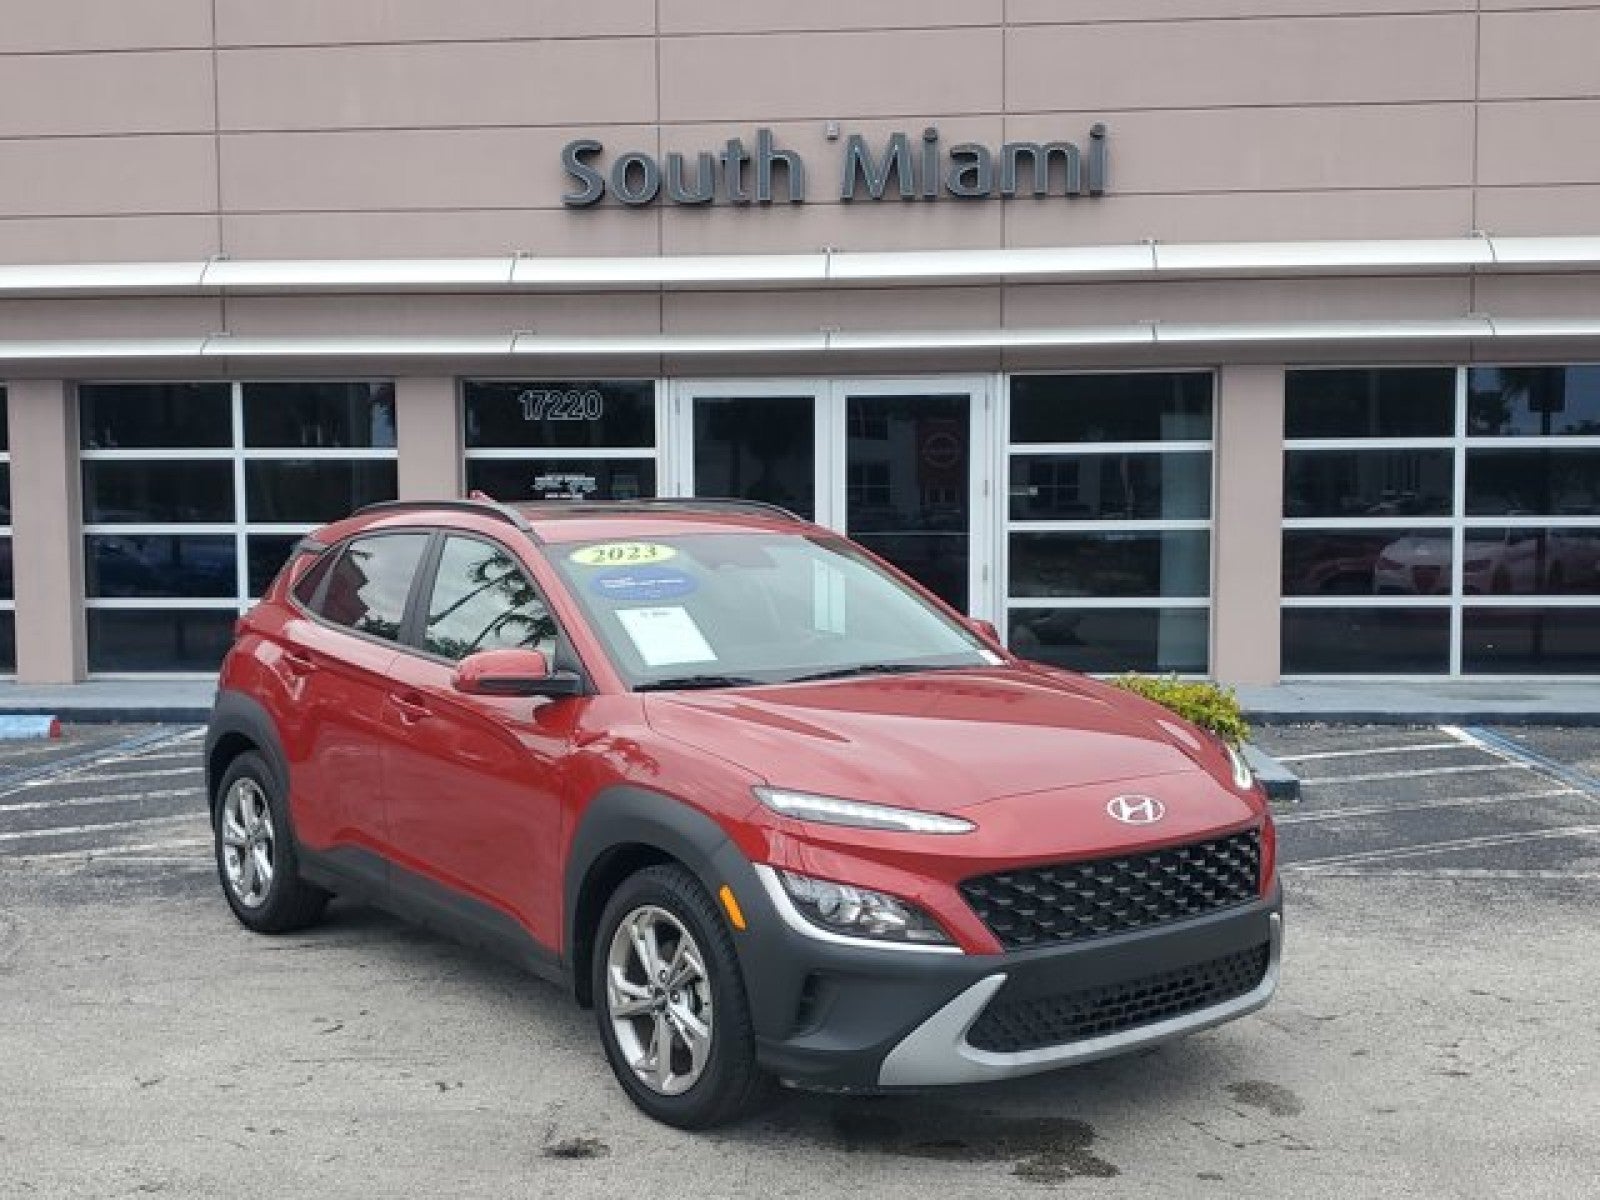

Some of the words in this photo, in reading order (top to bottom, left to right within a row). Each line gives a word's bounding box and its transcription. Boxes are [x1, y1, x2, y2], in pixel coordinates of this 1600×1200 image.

[561, 127, 806, 208] South
[840, 122, 1109, 201] Miami
[518, 389, 603, 421] 17220
[591, 545, 659, 564] 2023
